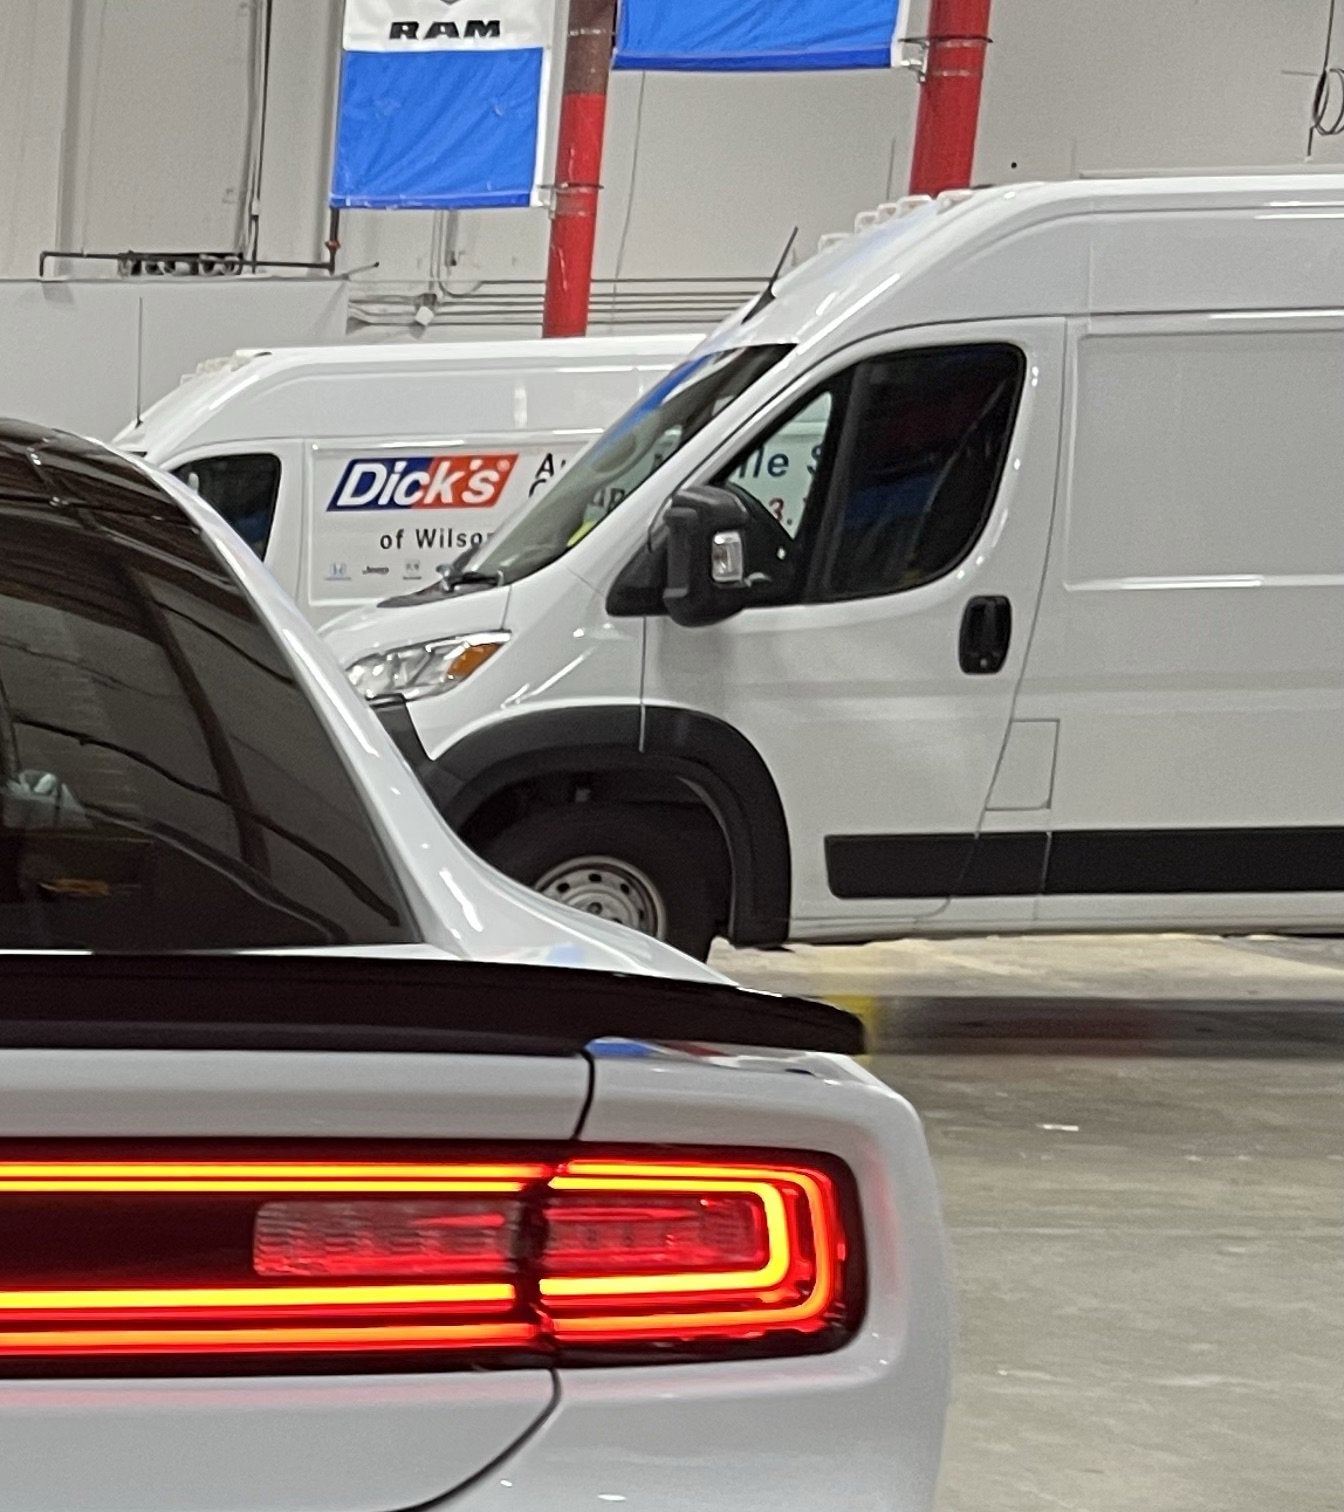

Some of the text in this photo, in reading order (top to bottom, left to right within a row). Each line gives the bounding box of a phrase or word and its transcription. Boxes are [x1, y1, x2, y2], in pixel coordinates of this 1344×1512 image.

[389, 20, 501, 40] RAM
[337, 459, 502, 507] Dick's
[380, 528, 491, 549] of Wilso
